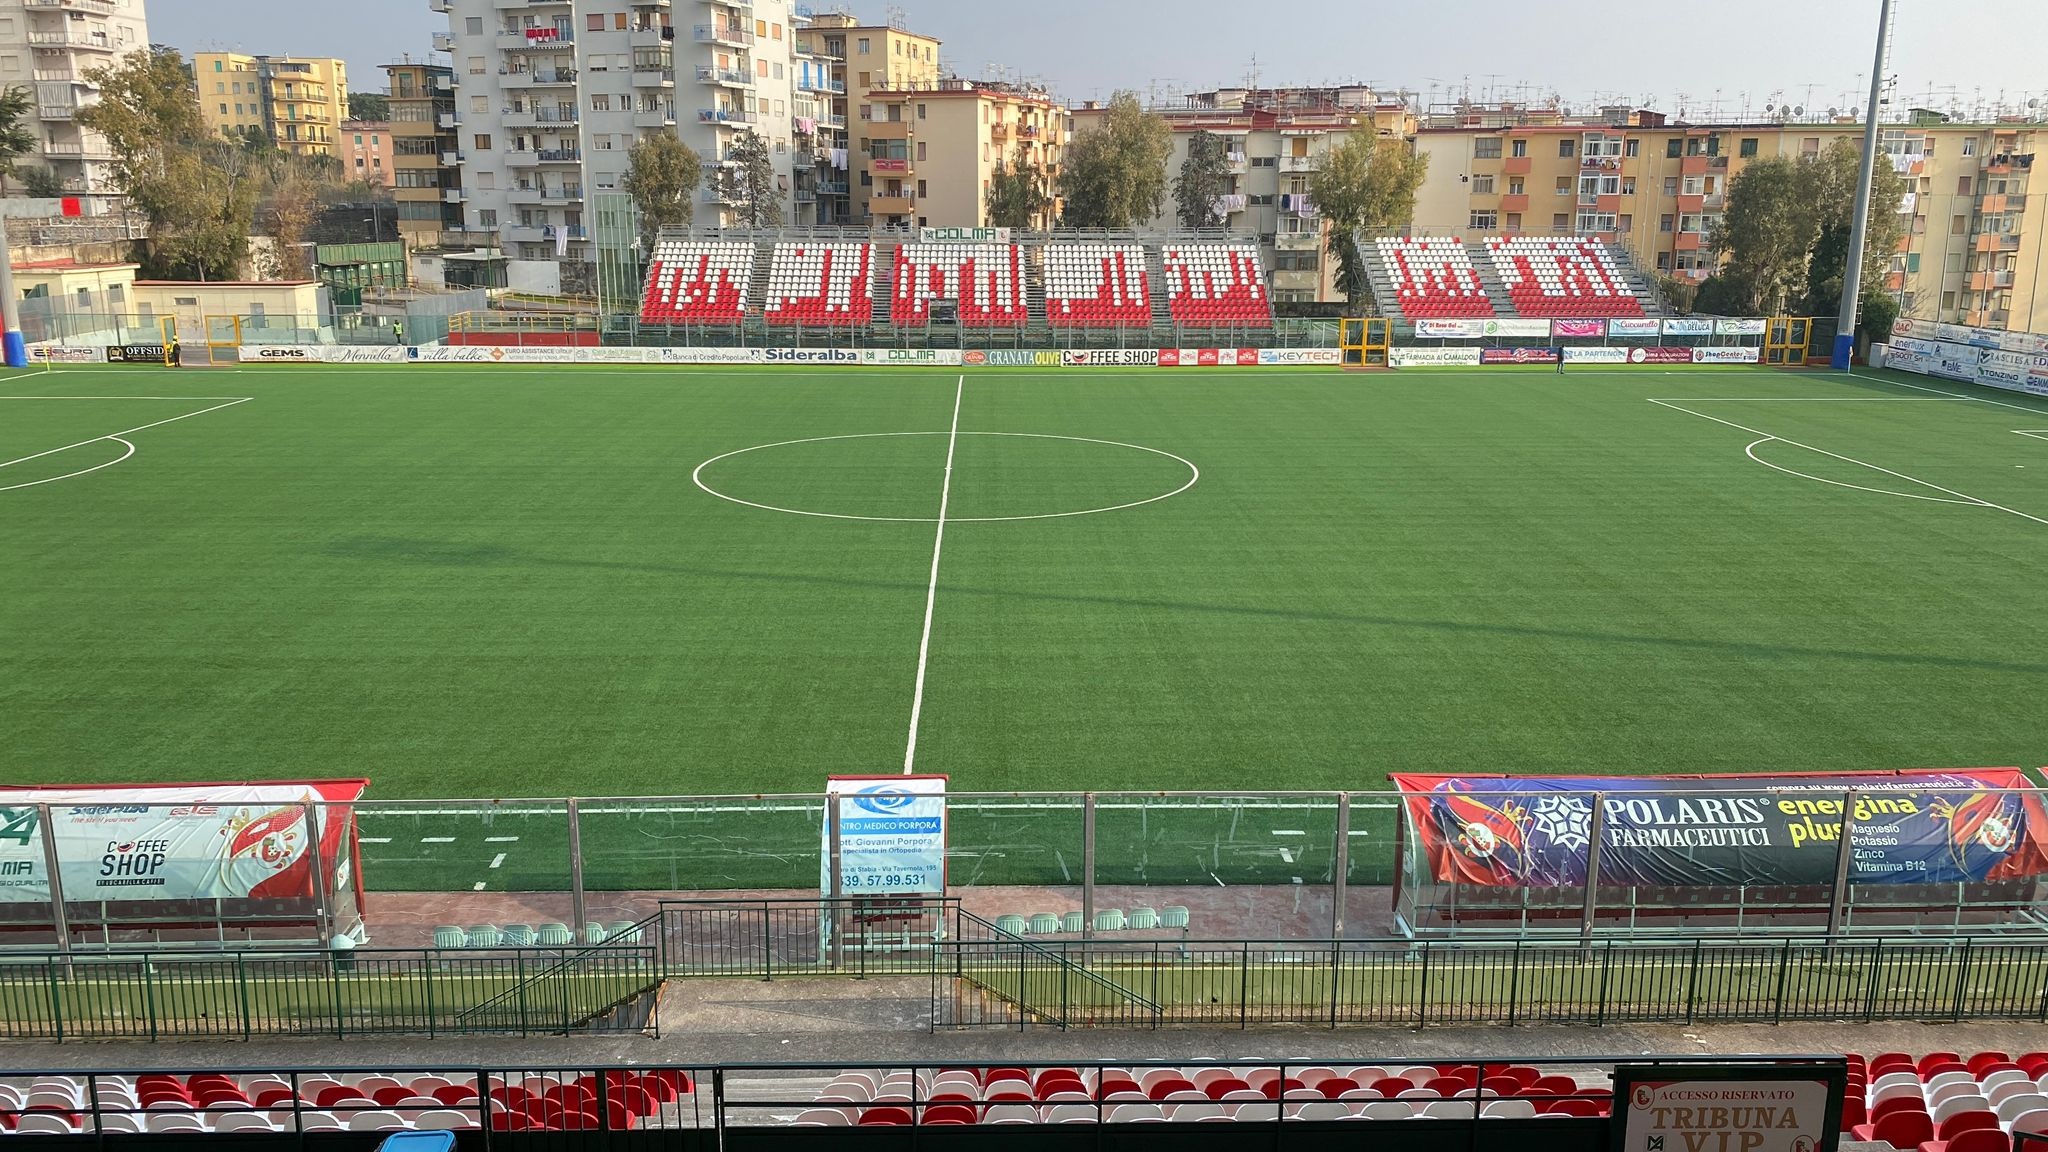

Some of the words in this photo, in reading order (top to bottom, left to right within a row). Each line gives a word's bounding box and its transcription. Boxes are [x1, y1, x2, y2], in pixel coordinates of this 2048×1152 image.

[935, 228, 996, 240] COLMA
[673, 353, 692, 361] Banca
[700, 353, 722, 361] Credito
[722, 353, 750, 362] Popolare
[765, 349, 857, 361] Sideralba
[888, 350, 936, 359] COLMA
[1124, 350, 1158, 362] SHOP
[1278, 352, 1340, 361] KEYTECH
[1985, 369, 2019, 381] TONZINO
[863, 821, 897, 830] MEDICO
[899, 821, 937, 830] PORPORA
[1609, 827, 1772, 848] FARMACEUTICI
[1788, 816, 1841, 849] plus
[856, 838, 895, 846] Giovanni
[897, 837, 932, 848] Porpora
[1851, 835, 1898, 846] Potassio
[888, 847, 922, 856] Ortopedia
[1854, 848, 1884, 859] Zinco
[100, 853, 166, 876] SHOP
[858, 865, 877, 873] Stabia
[1856, 861, 1904, 872] Vitamina
[1905, 860, 1926, 871] B12
[867, 874, 926, 887] 57.99.531
[1660, 1091, 1718, 1100] ACCESSO
[1721, 1090, 1795, 1100] RISERVATO
[1649, 1106, 1799, 1130] TRIBUNA
[1679, 1131, 1765, 1152] VIP
